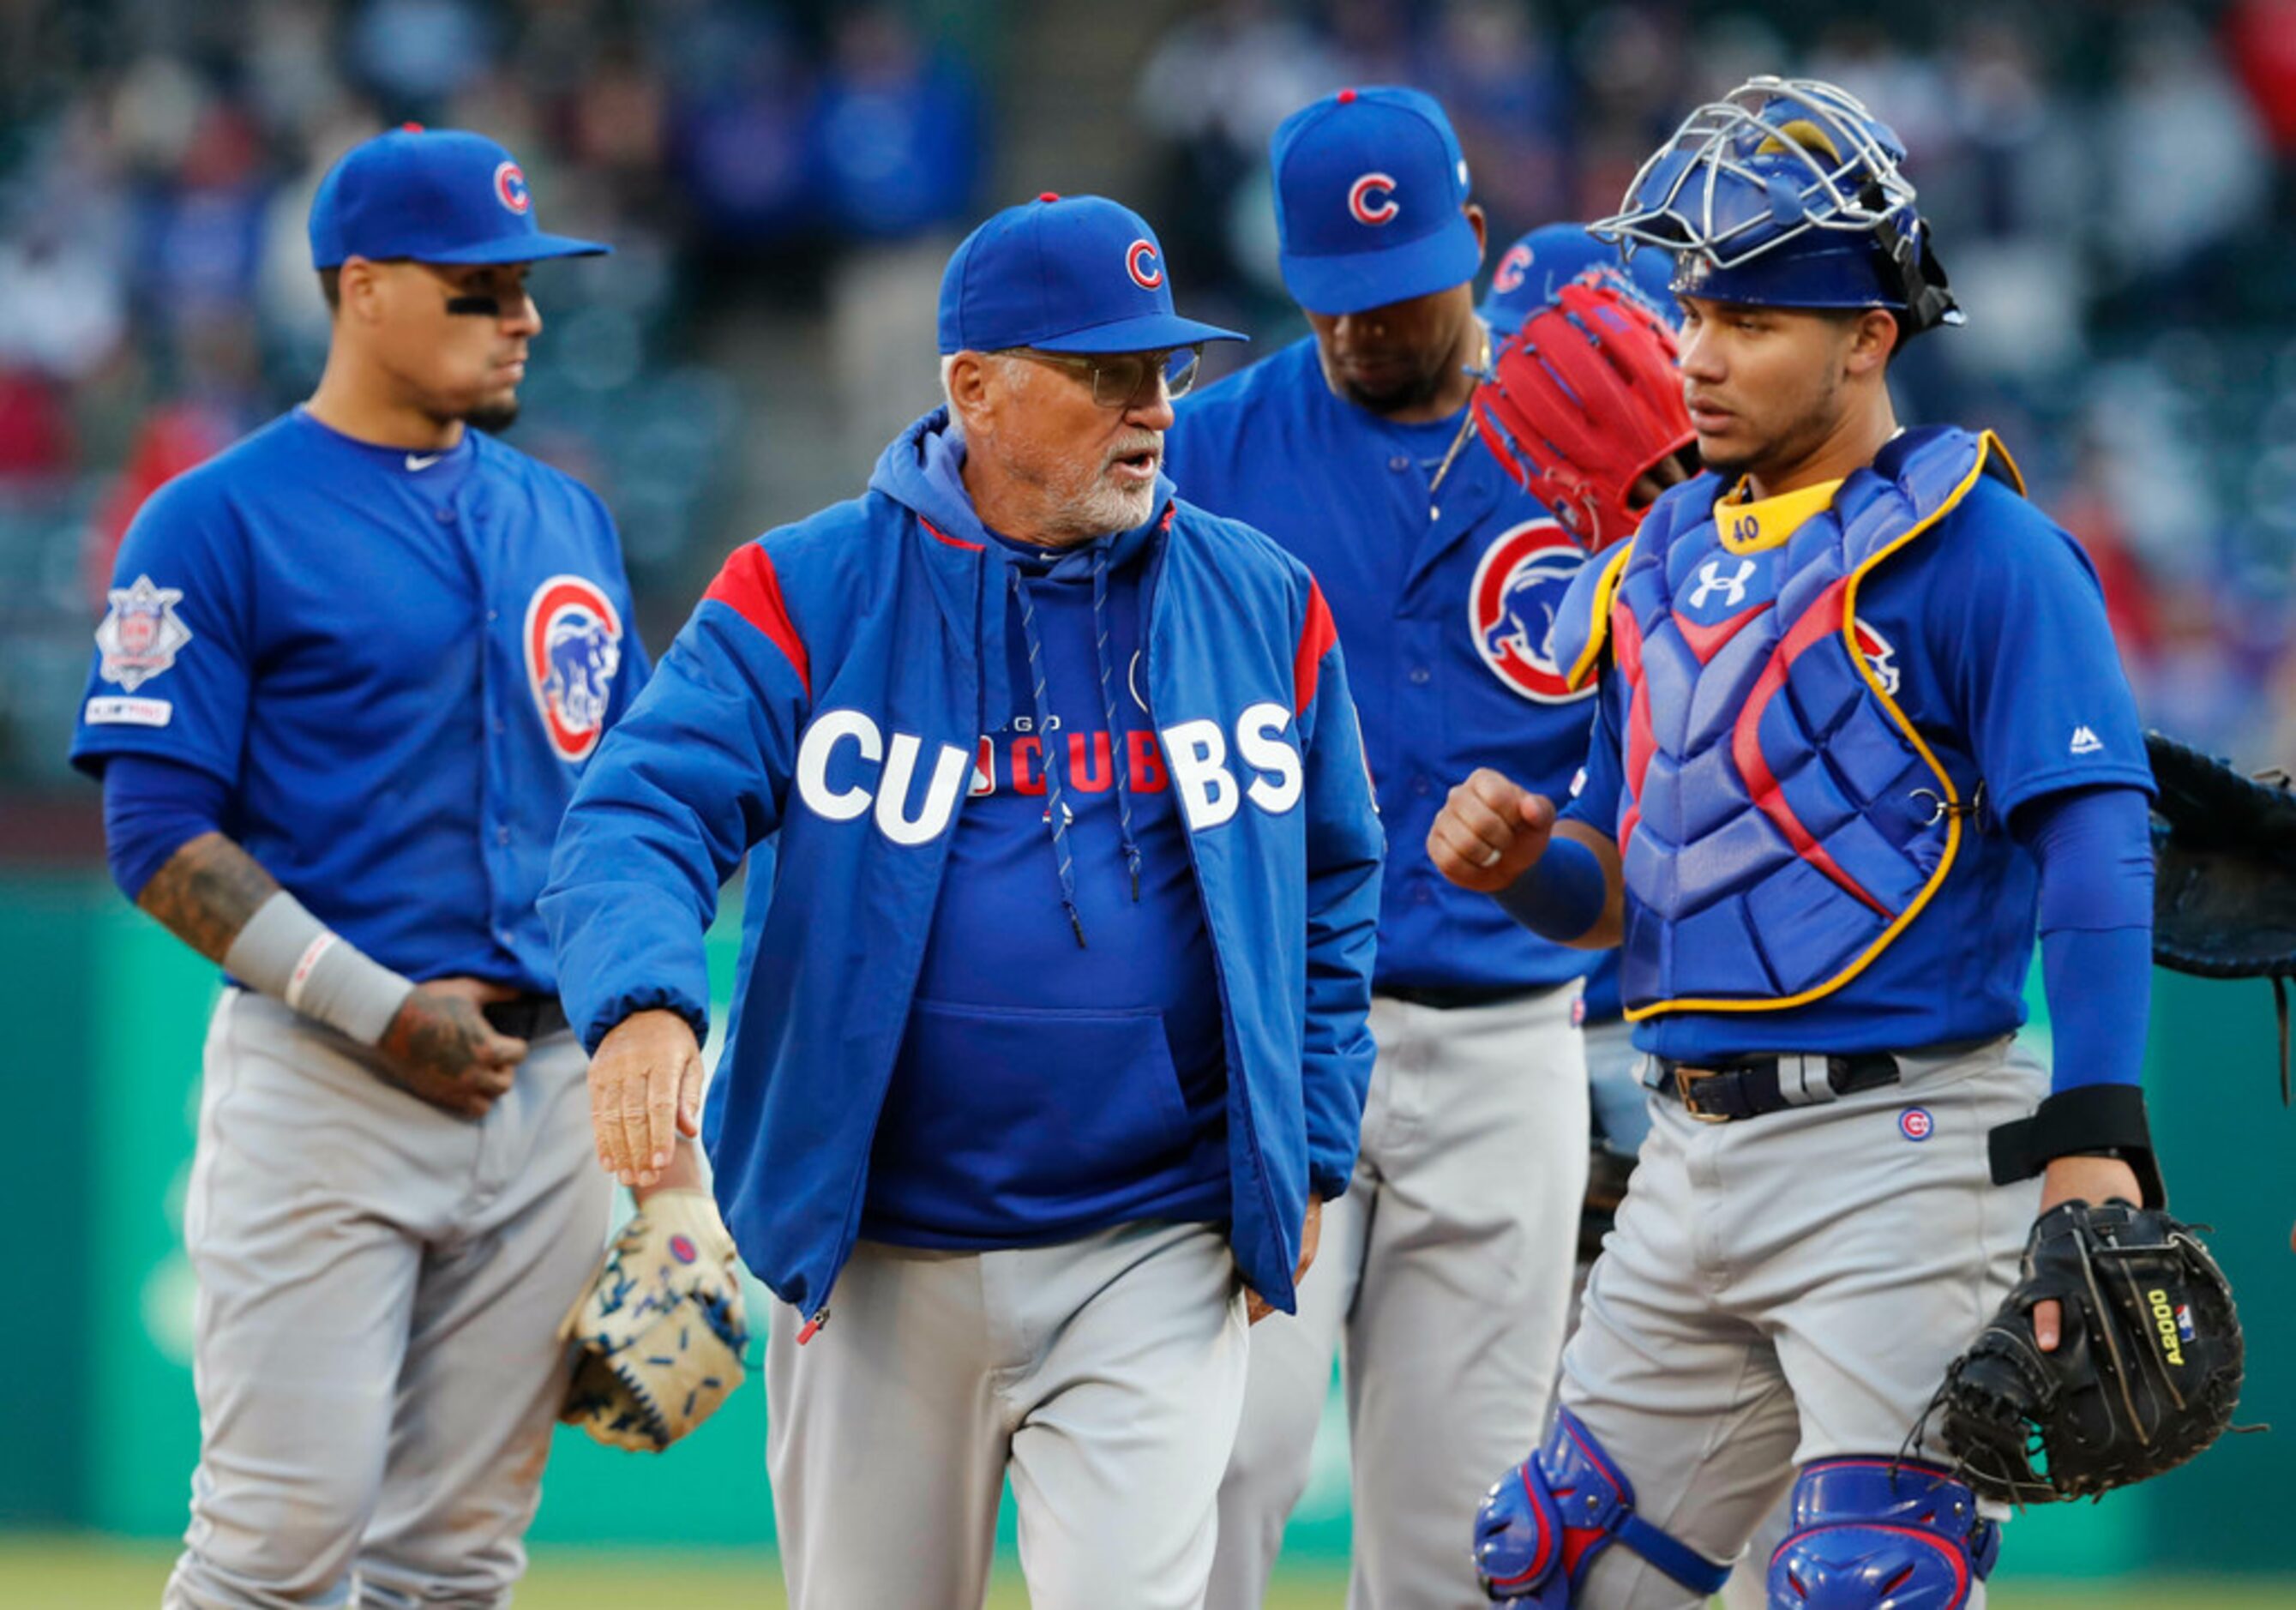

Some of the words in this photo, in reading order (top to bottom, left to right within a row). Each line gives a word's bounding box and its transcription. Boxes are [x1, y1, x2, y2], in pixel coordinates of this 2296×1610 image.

[494, 160, 530, 215] C
[1349, 172, 1399, 225] C
[1125, 239, 1163, 291] C
[1494, 245, 1534, 293] C
[1733, 514, 1759, 543] 40
[2148, 1289, 2185, 1366] A2000
